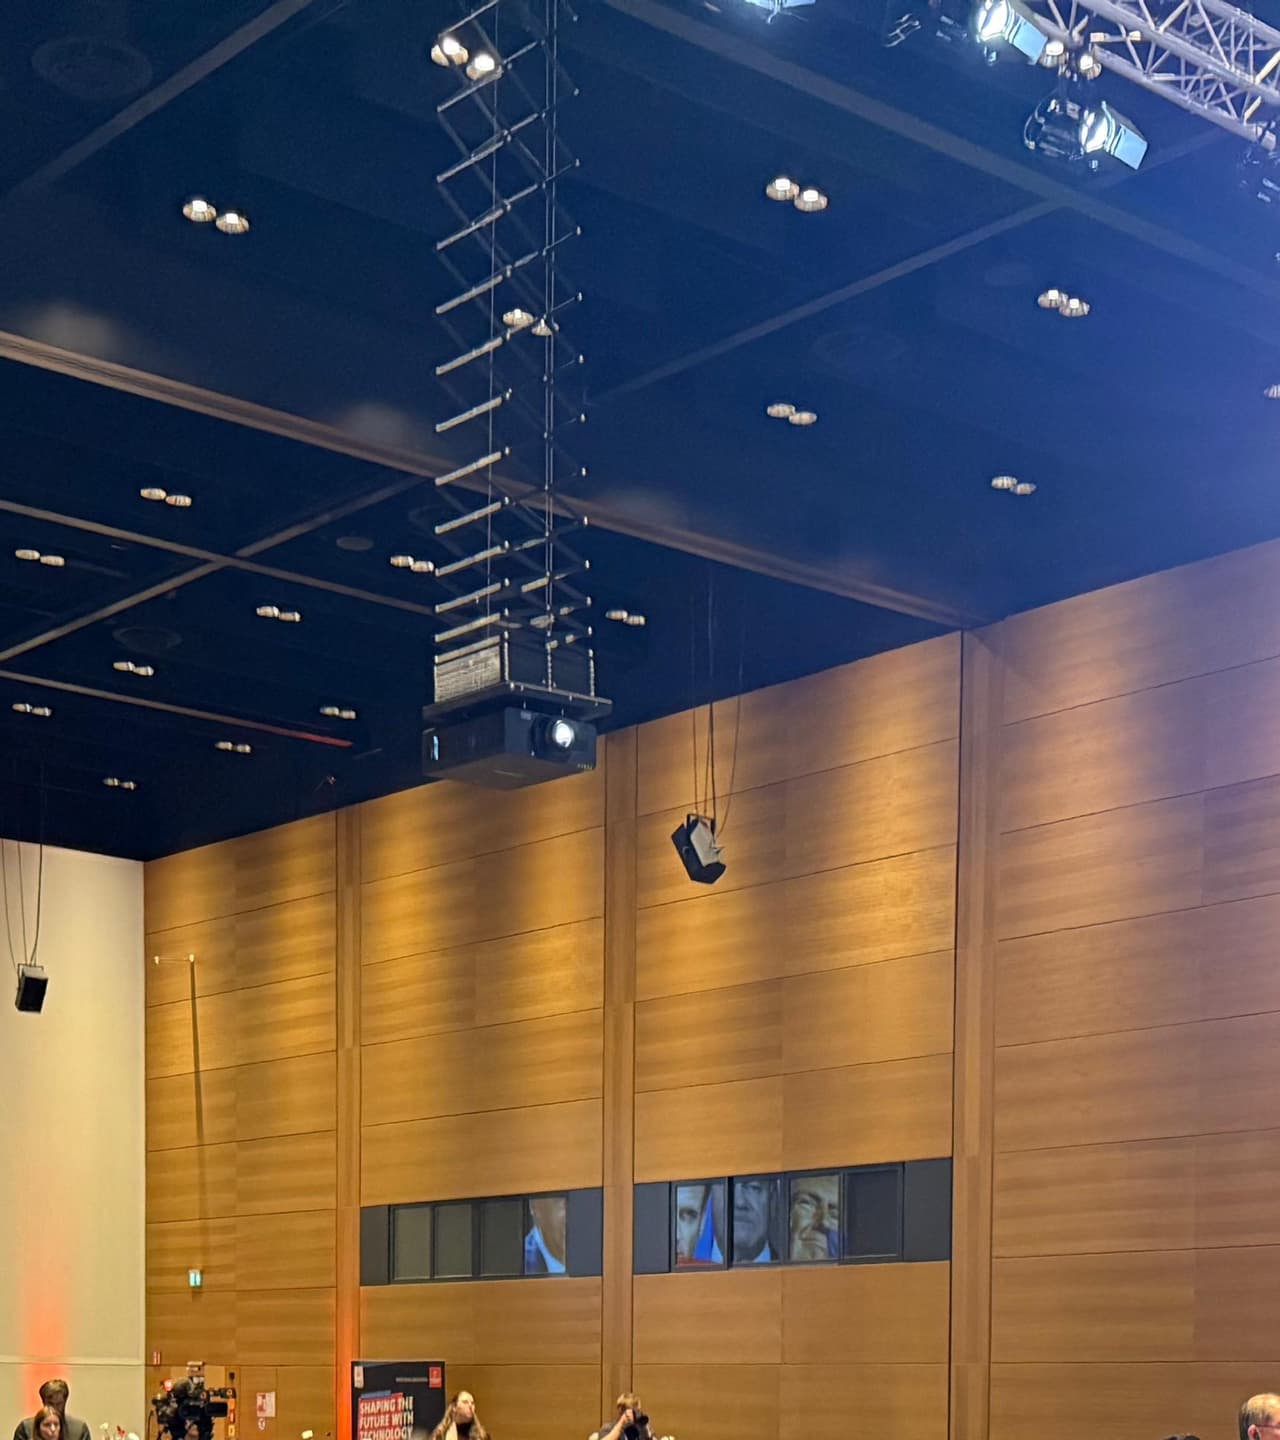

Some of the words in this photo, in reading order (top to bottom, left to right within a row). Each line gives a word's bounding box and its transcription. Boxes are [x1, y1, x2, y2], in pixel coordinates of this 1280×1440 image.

[360, 1399, 396, 1414] SHAPING
[398, 1396, 413, 1410] THE
[360, 1414, 390, 1429] FUTURE
[392, 1411, 414, 1426] WITH
